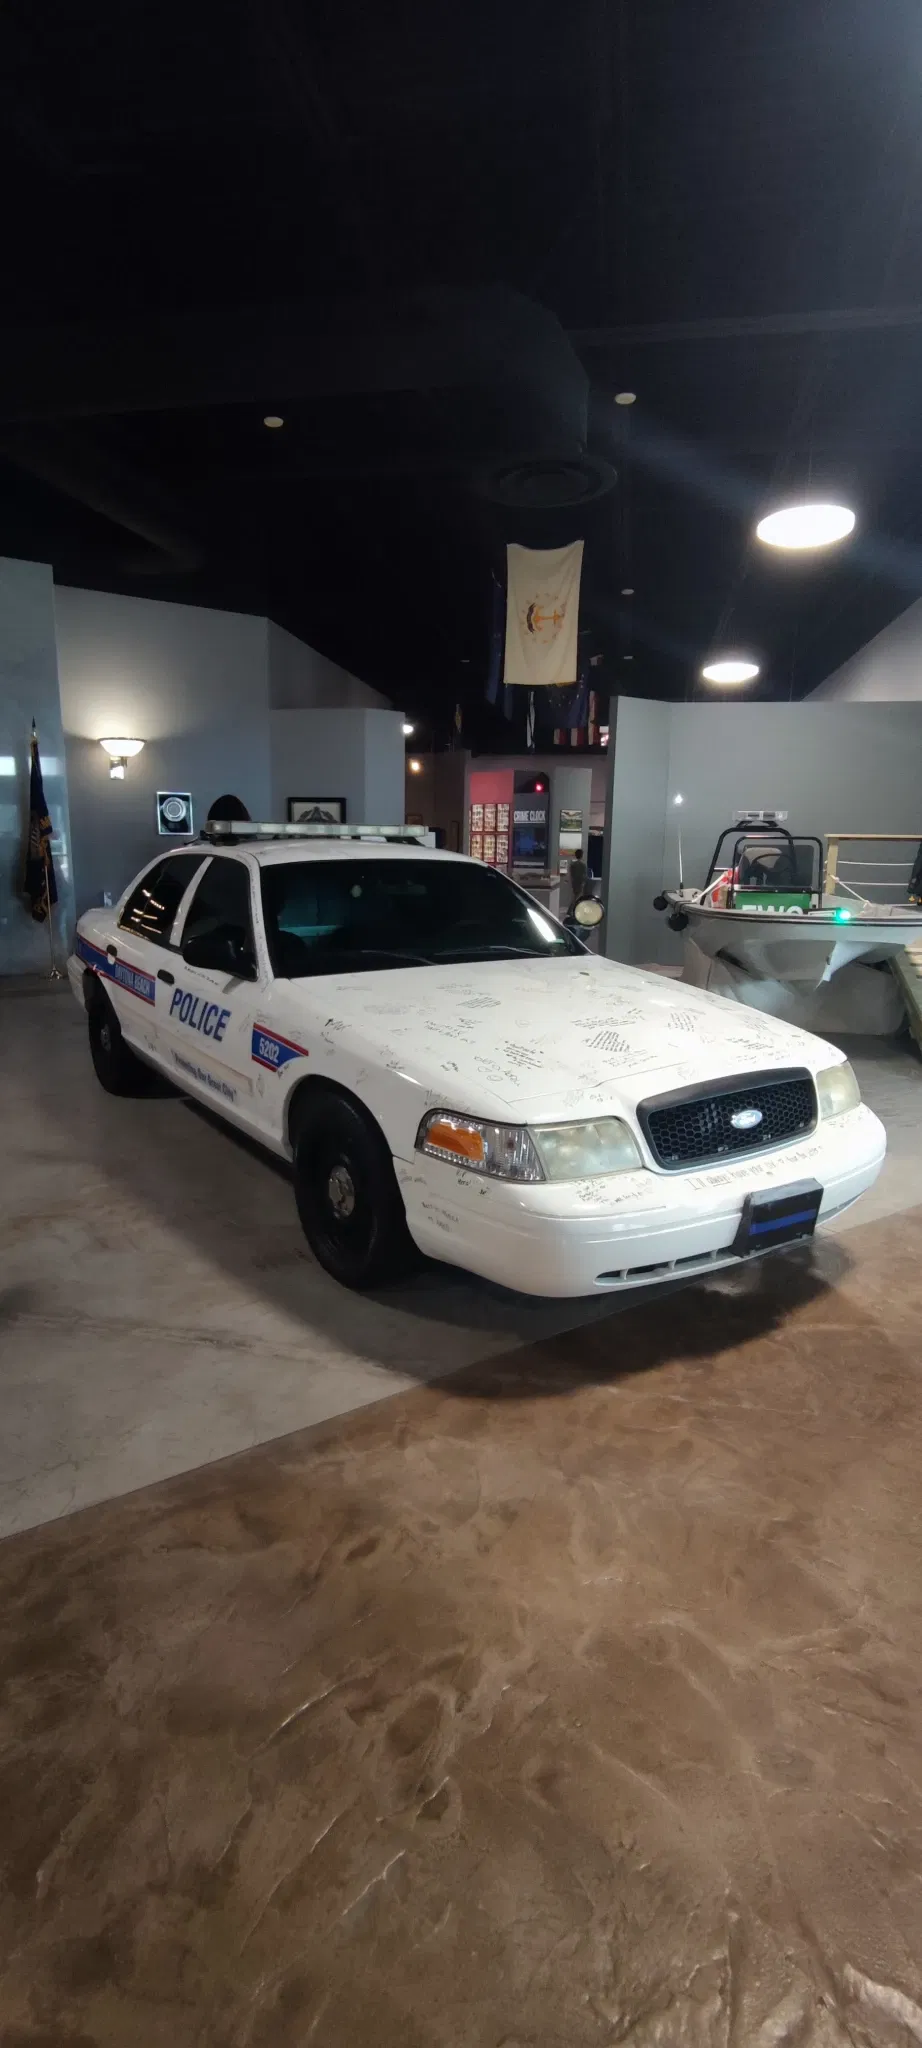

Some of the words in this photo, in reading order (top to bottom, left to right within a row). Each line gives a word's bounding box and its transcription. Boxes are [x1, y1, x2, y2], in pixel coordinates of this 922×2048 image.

[513, 810, 530, 821] CRIME
[529, 810, 546, 821] CLOCK
[169, 988, 232, 1042] POLICE
[259, 1037, 280, 1064] 5202
